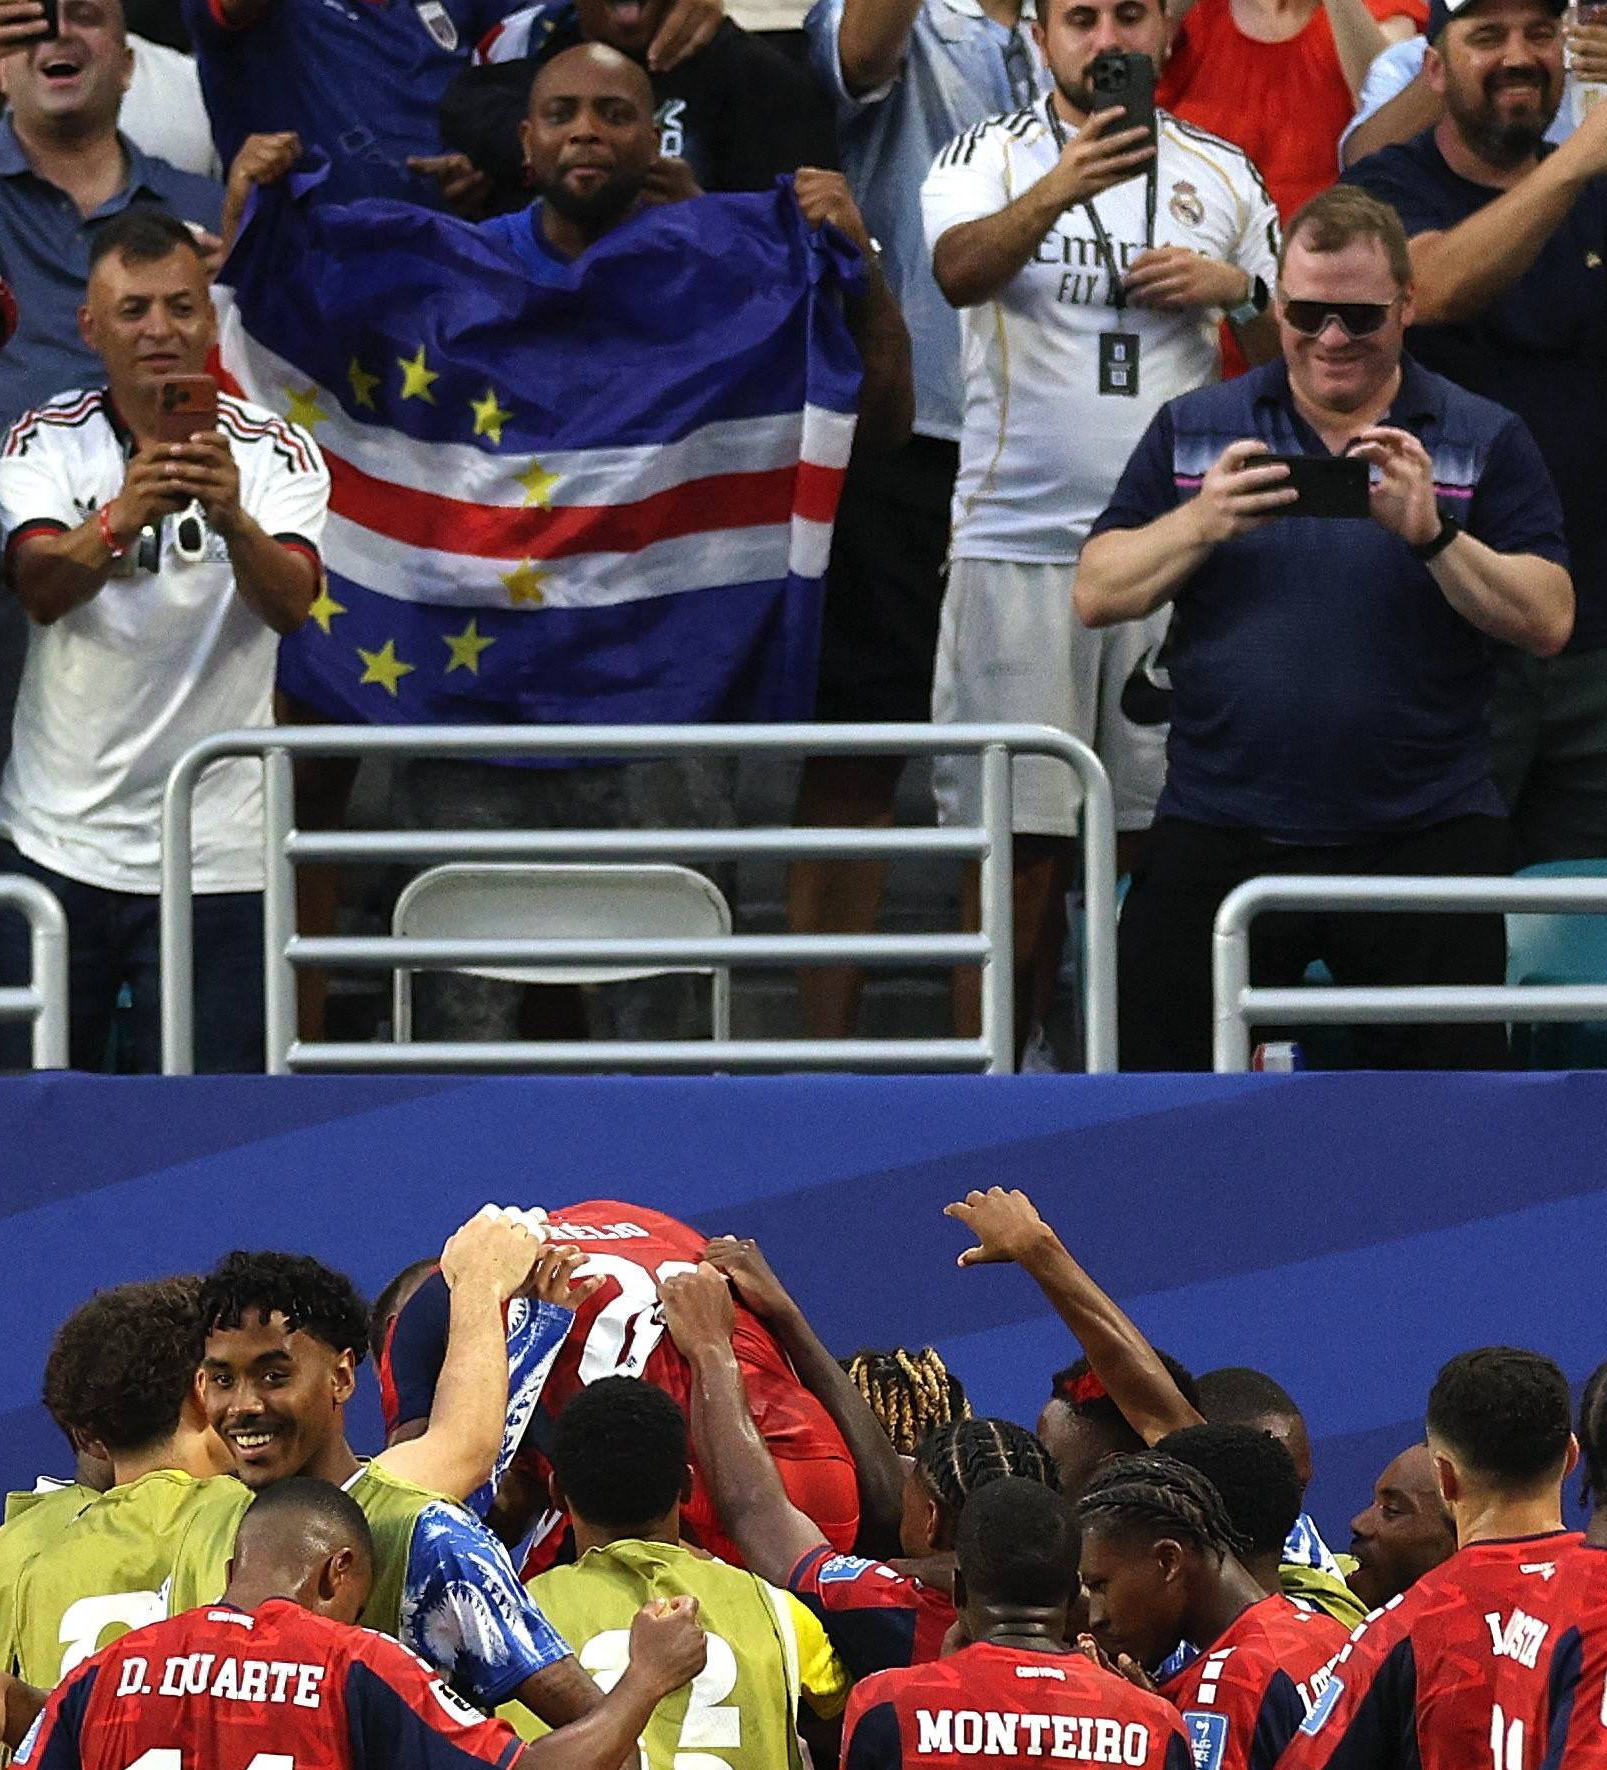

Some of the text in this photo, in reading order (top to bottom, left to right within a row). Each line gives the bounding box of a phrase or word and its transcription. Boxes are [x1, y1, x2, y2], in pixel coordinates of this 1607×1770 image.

[116, 1657, 326, 1709] D. DUARTE
[917, 1709, 1149, 1767] MONTEIRO
